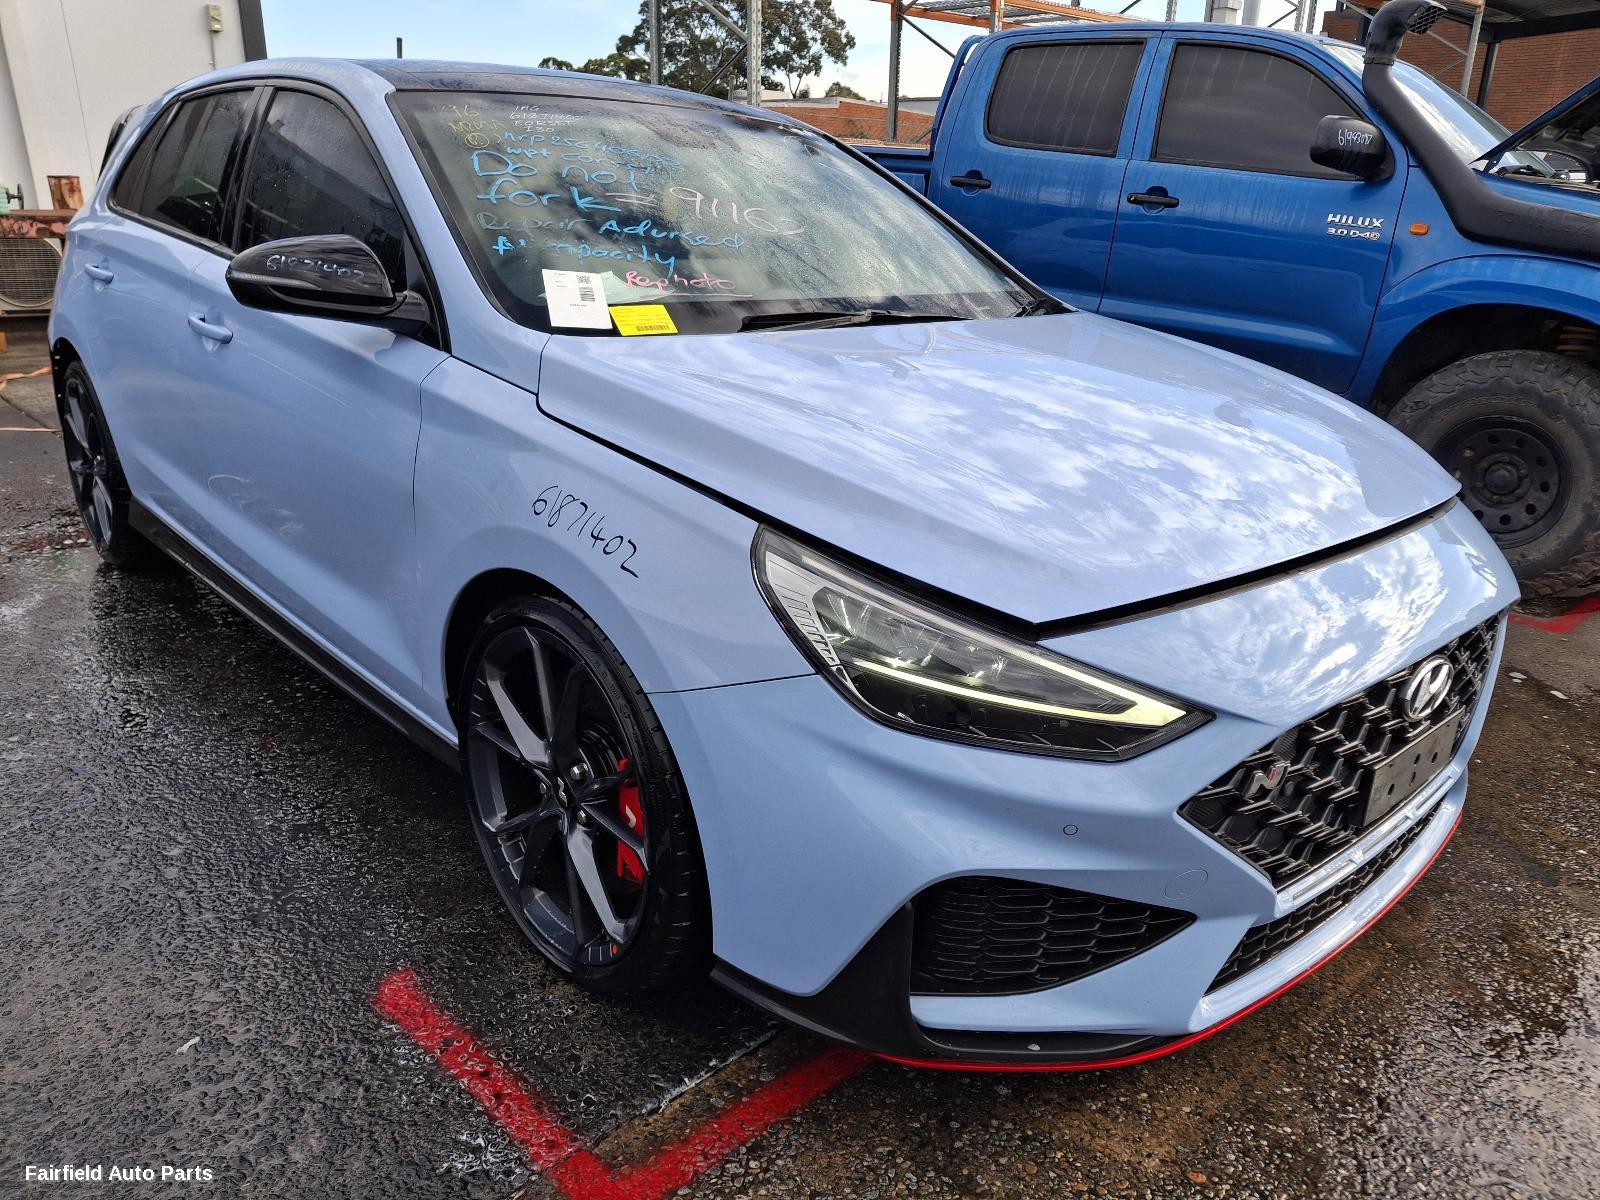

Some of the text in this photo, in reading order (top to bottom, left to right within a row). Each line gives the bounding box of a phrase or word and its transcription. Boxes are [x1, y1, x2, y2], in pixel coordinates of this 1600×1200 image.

[472, 149, 538, 177] Do
[1327, 213, 1385, 229] HILUX
[1349, 230, 1380, 241] D-4D
[532, 485, 639, 579] 61871402
